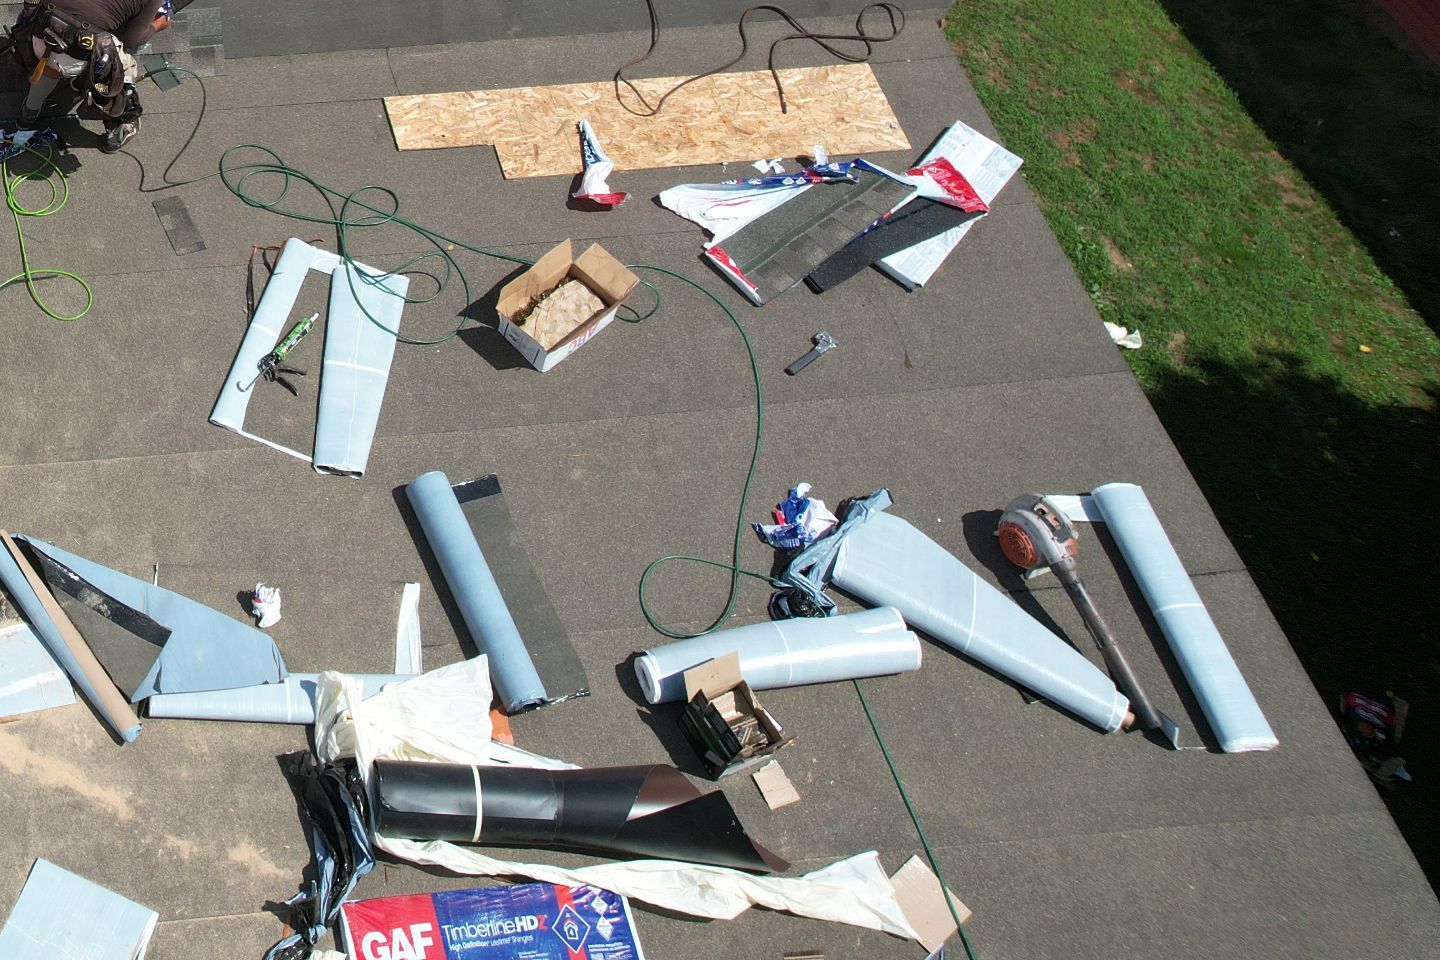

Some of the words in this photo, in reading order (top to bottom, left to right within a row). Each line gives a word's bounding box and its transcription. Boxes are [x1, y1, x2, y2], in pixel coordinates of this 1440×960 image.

[362, 922, 435, 960] GAF
[449, 942, 462, 952] High
[511, 935, 534, 946] Shingles
